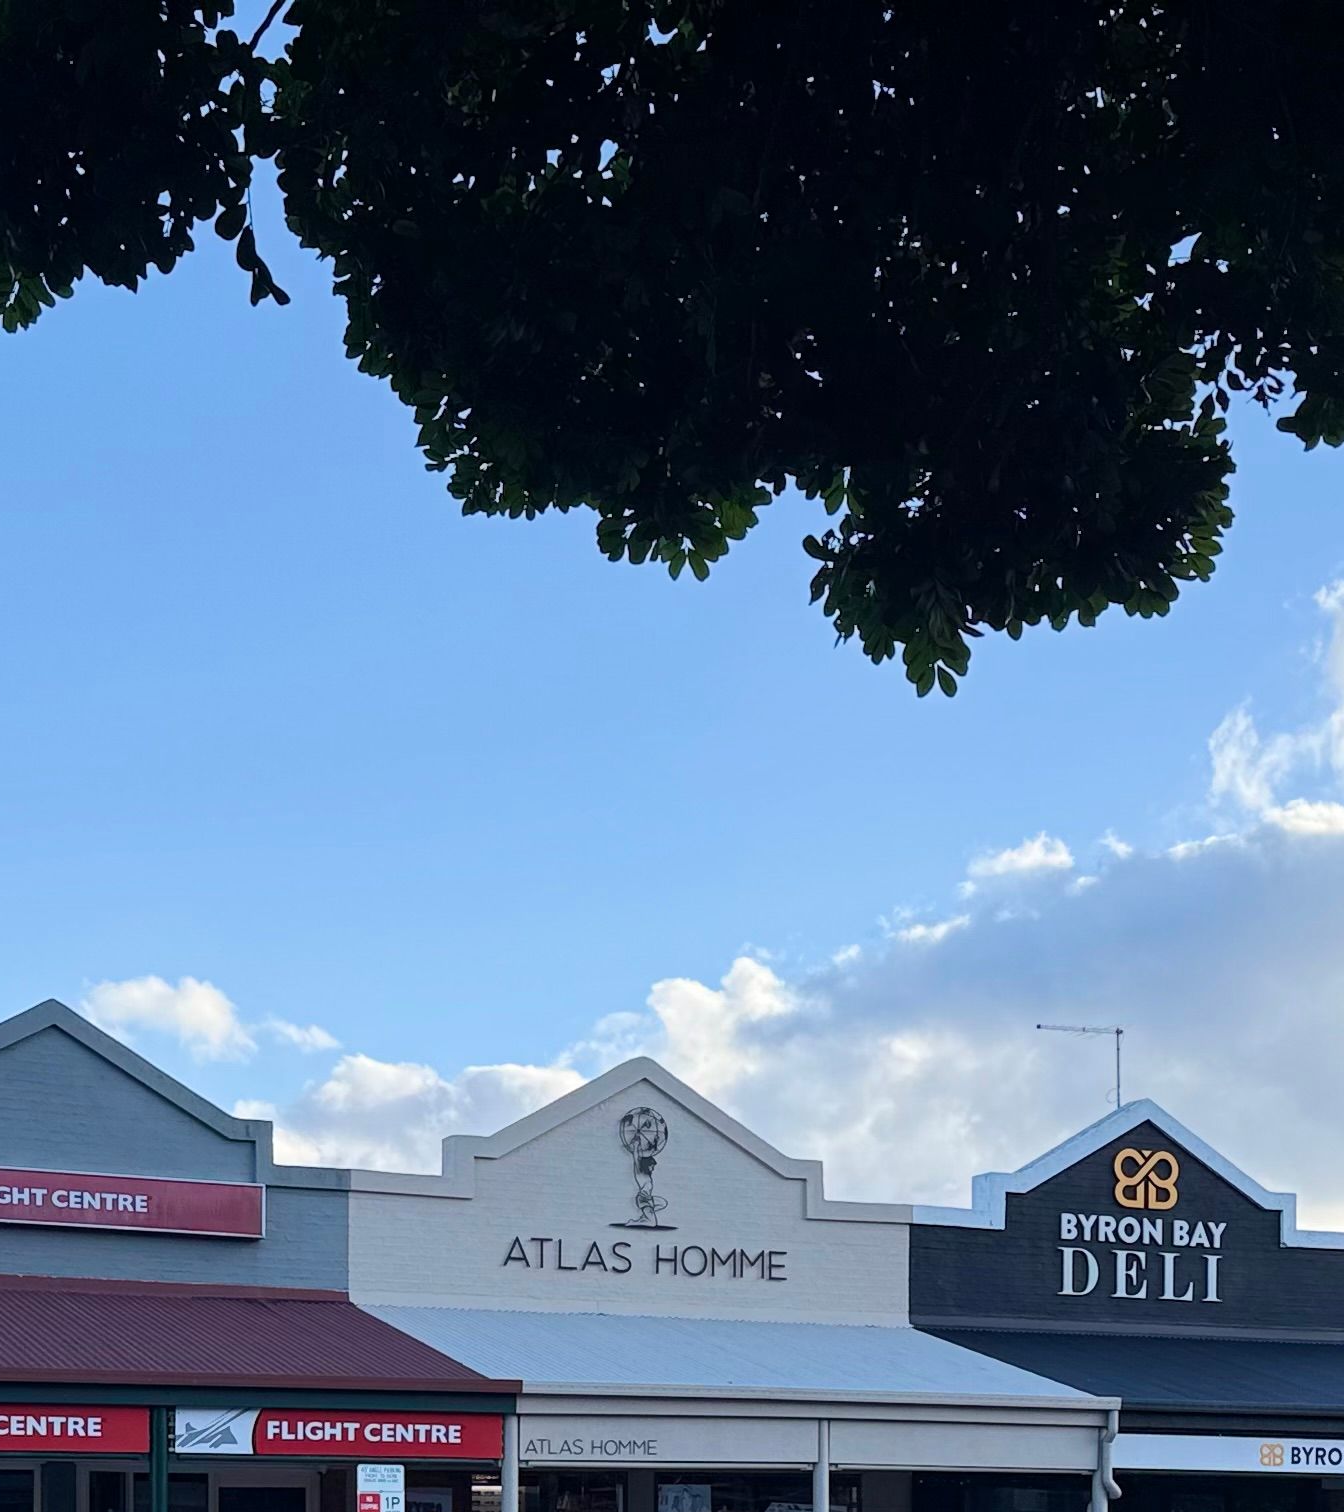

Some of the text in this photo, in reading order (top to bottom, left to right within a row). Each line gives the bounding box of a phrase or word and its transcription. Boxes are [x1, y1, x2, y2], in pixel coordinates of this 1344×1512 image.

[51, 1189, 149, 1213] CENTRE
[1060, 1212, 1228, 1249] BYRON BAY
[502, 1235, 788, 1281] ATLAS HOMME
[1056, 1246, 1224, 1303] DELI
[266, 1420, 462, 1444] FLIGHT CENTRE
[524, 1438, 658, 1456] ATLAS HOMME
[385, 1496, 401, 1510] 1P
